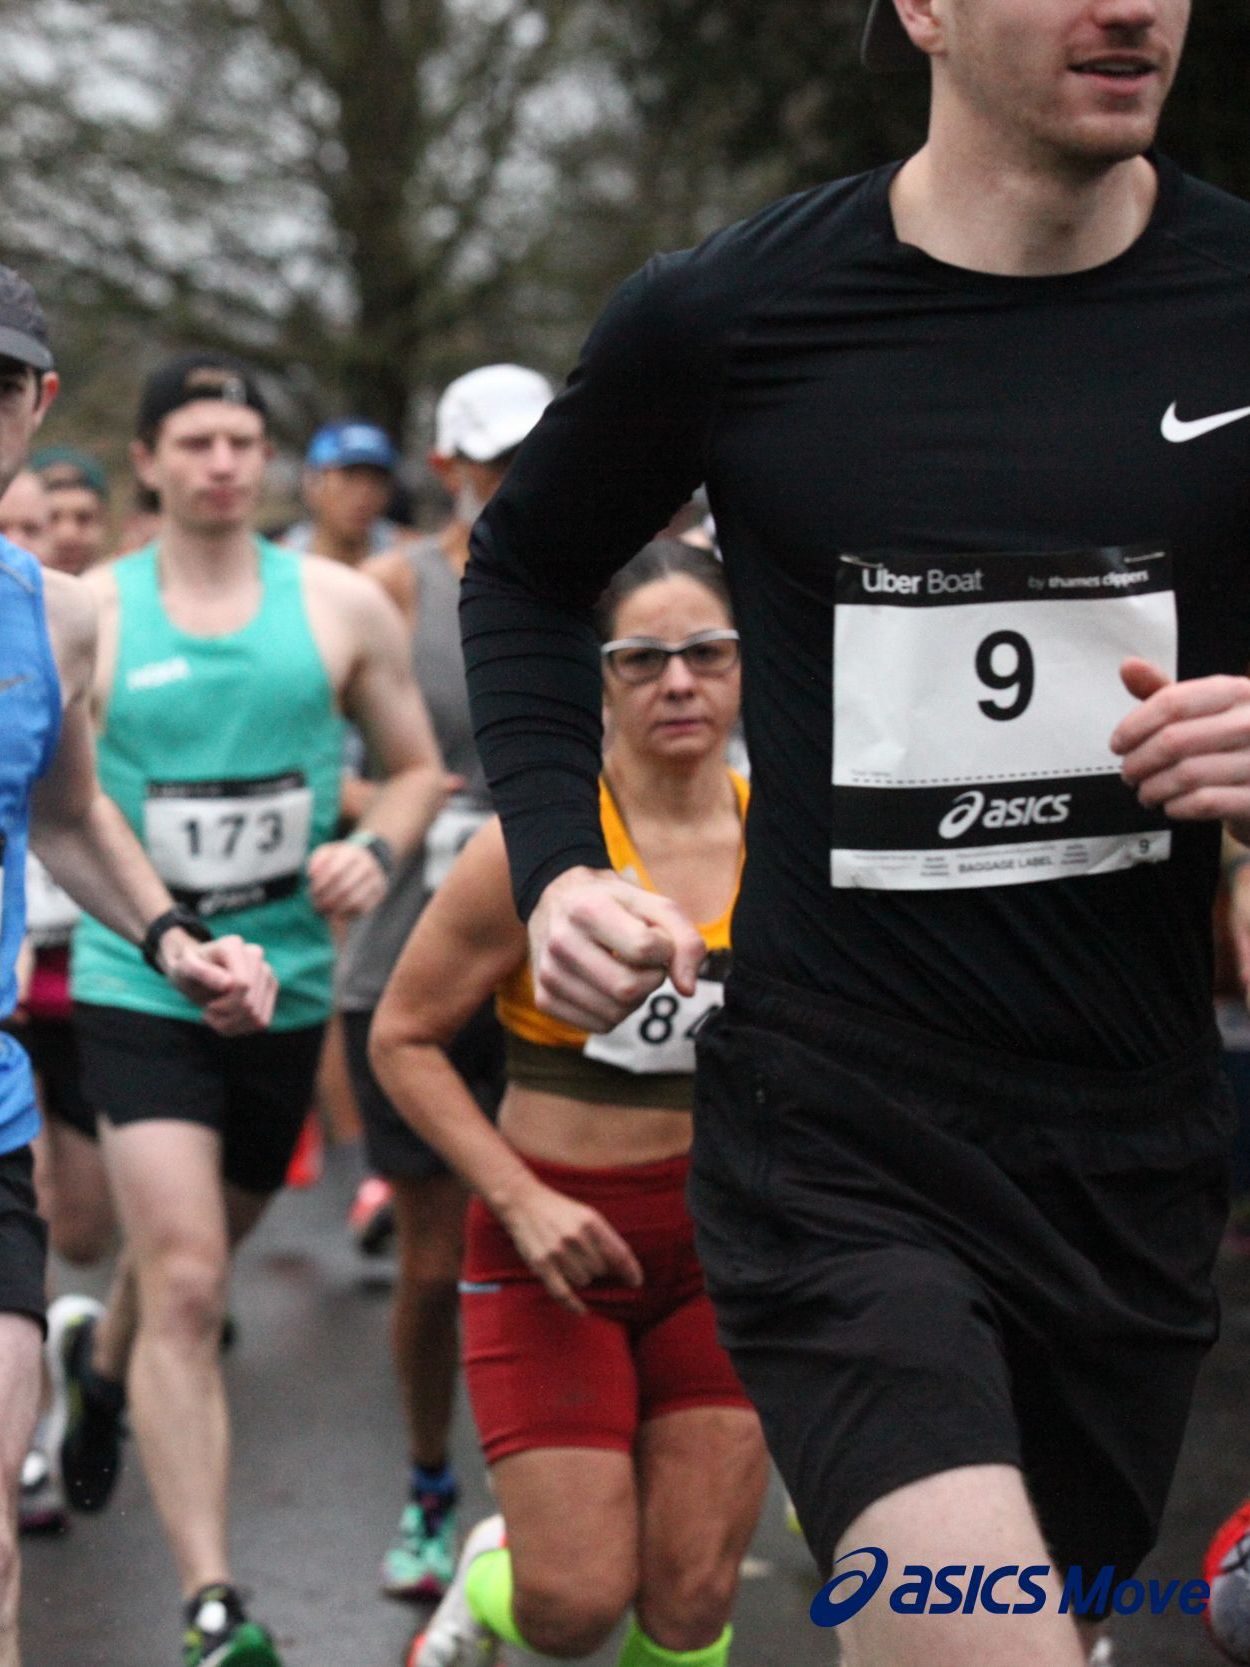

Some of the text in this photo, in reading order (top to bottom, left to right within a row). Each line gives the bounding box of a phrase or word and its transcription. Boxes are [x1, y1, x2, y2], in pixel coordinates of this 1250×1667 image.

[862, 567, 983, 594] Uber Boat
[1028, 570, 1149, 590] by thames clippers
[974, 629, 1035, 721] 9
[182, 810, 285, 858] 173
[1139, 838, 1150, 854] 9
[958, 859, 1014, 874] BAGGAGE
[1018, 856, 1053, 867] LABEL
